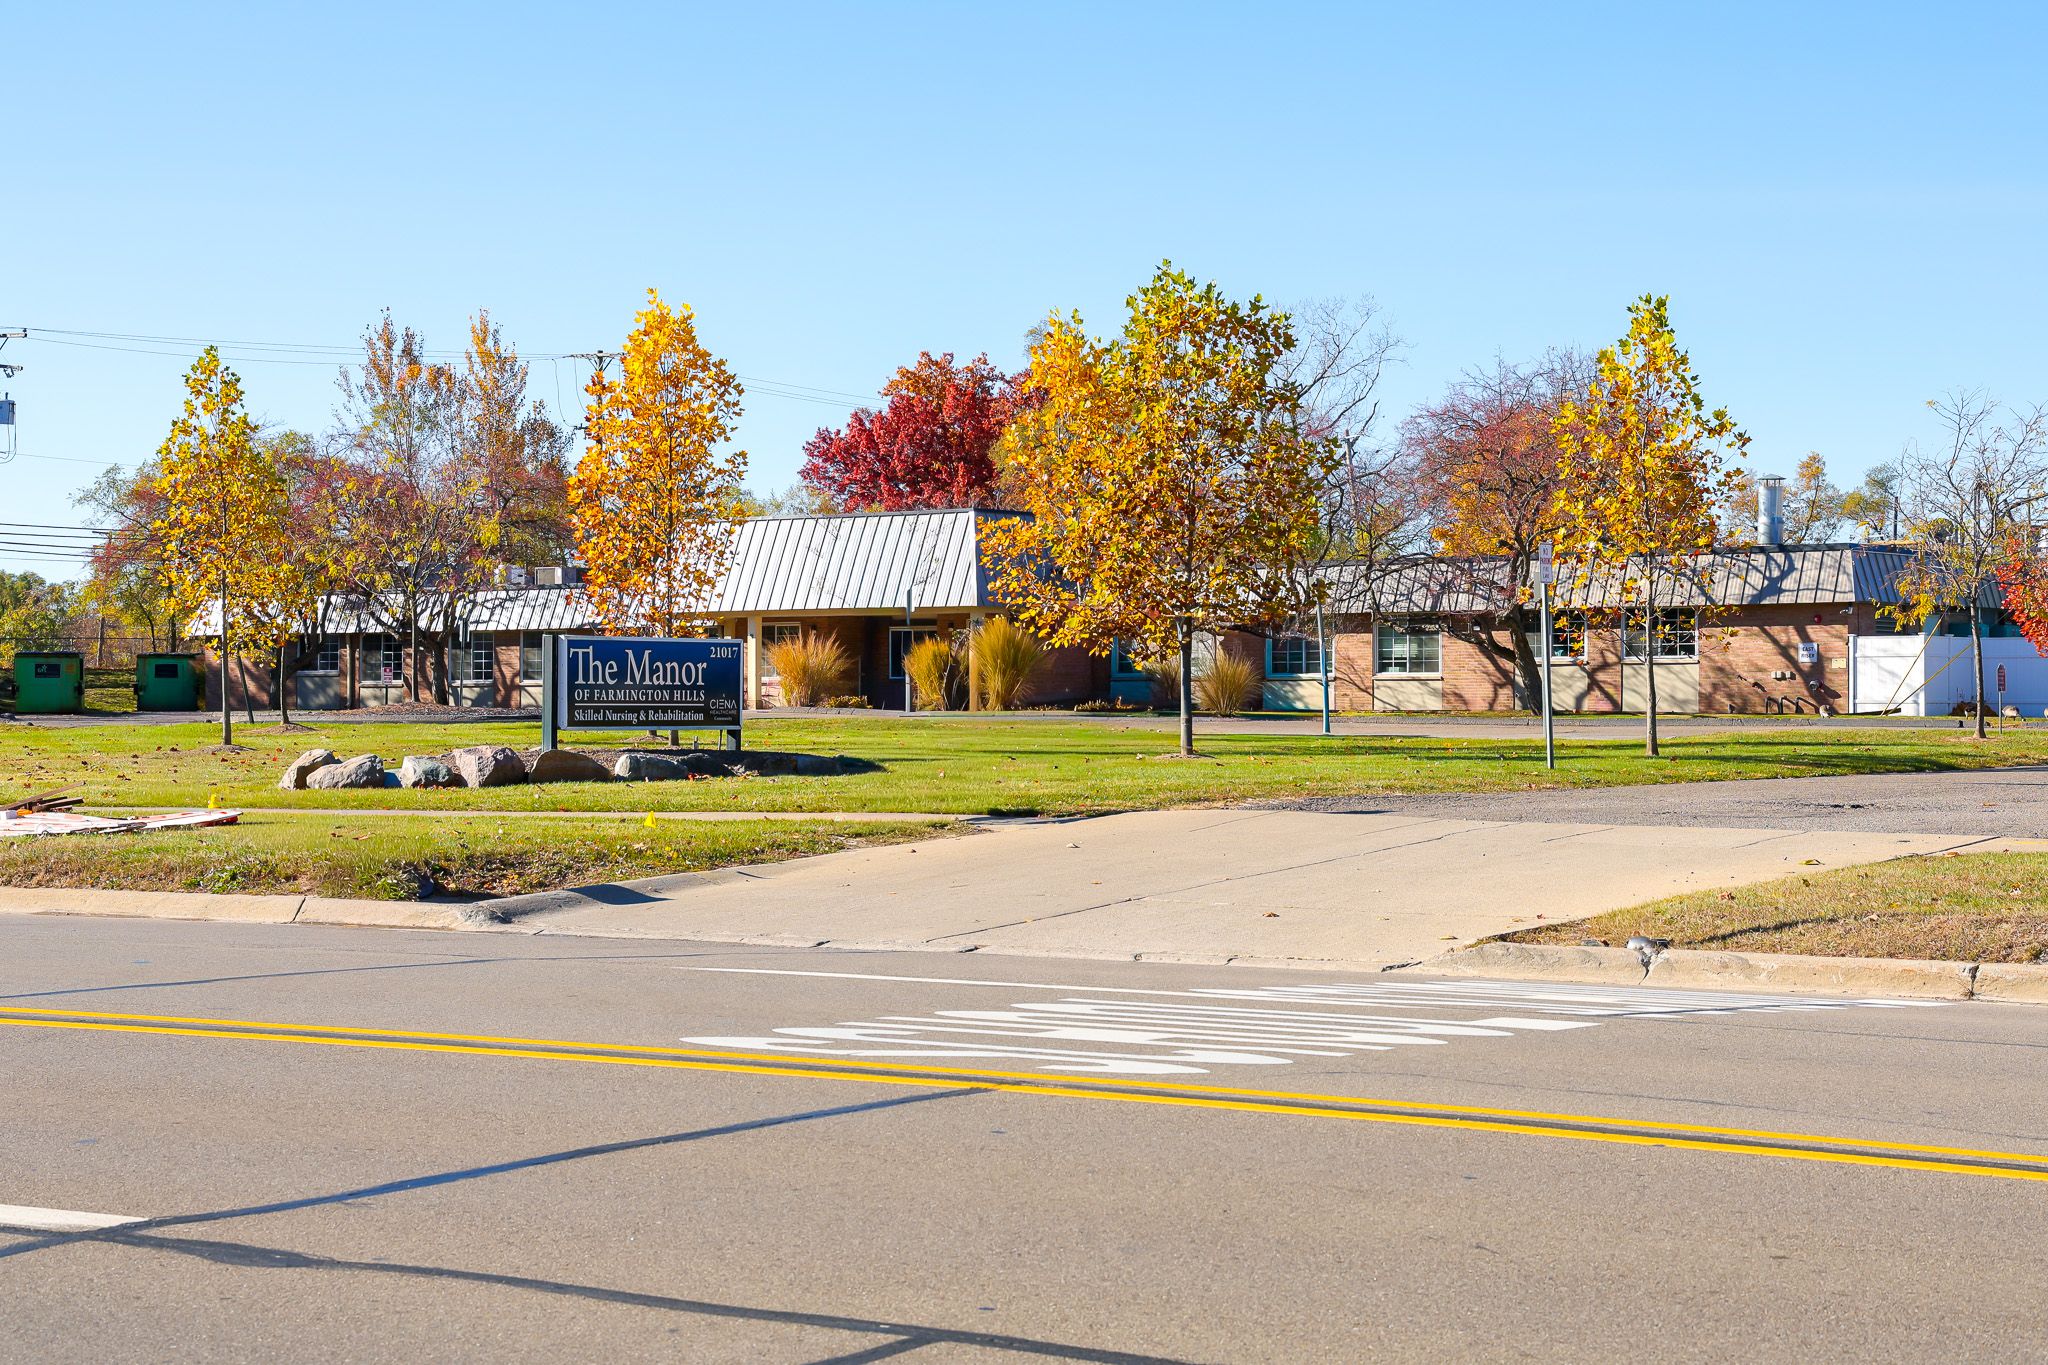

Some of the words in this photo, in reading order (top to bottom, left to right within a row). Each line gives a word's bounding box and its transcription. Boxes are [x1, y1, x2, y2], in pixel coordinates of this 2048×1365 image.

[709, 646, 738, 658] 21017
[570, 645, 618, 685] The
[624, 649, 707, 686] Manor
[574, 689, 590, 701] OF
[594, 689, 670, 701] FARMINGTON
[673, 690, 705, 702] HILLS
[709, 699, 737, 709] CIENA
[574, 710, 603, 721] Skilled
[605, 711, 638, 724] Nursing
[640, 711, 646, 721] &
[648, 711, 704, 721] Rehabilitation
[679, 998, 1601, 1074] SCHOOL
